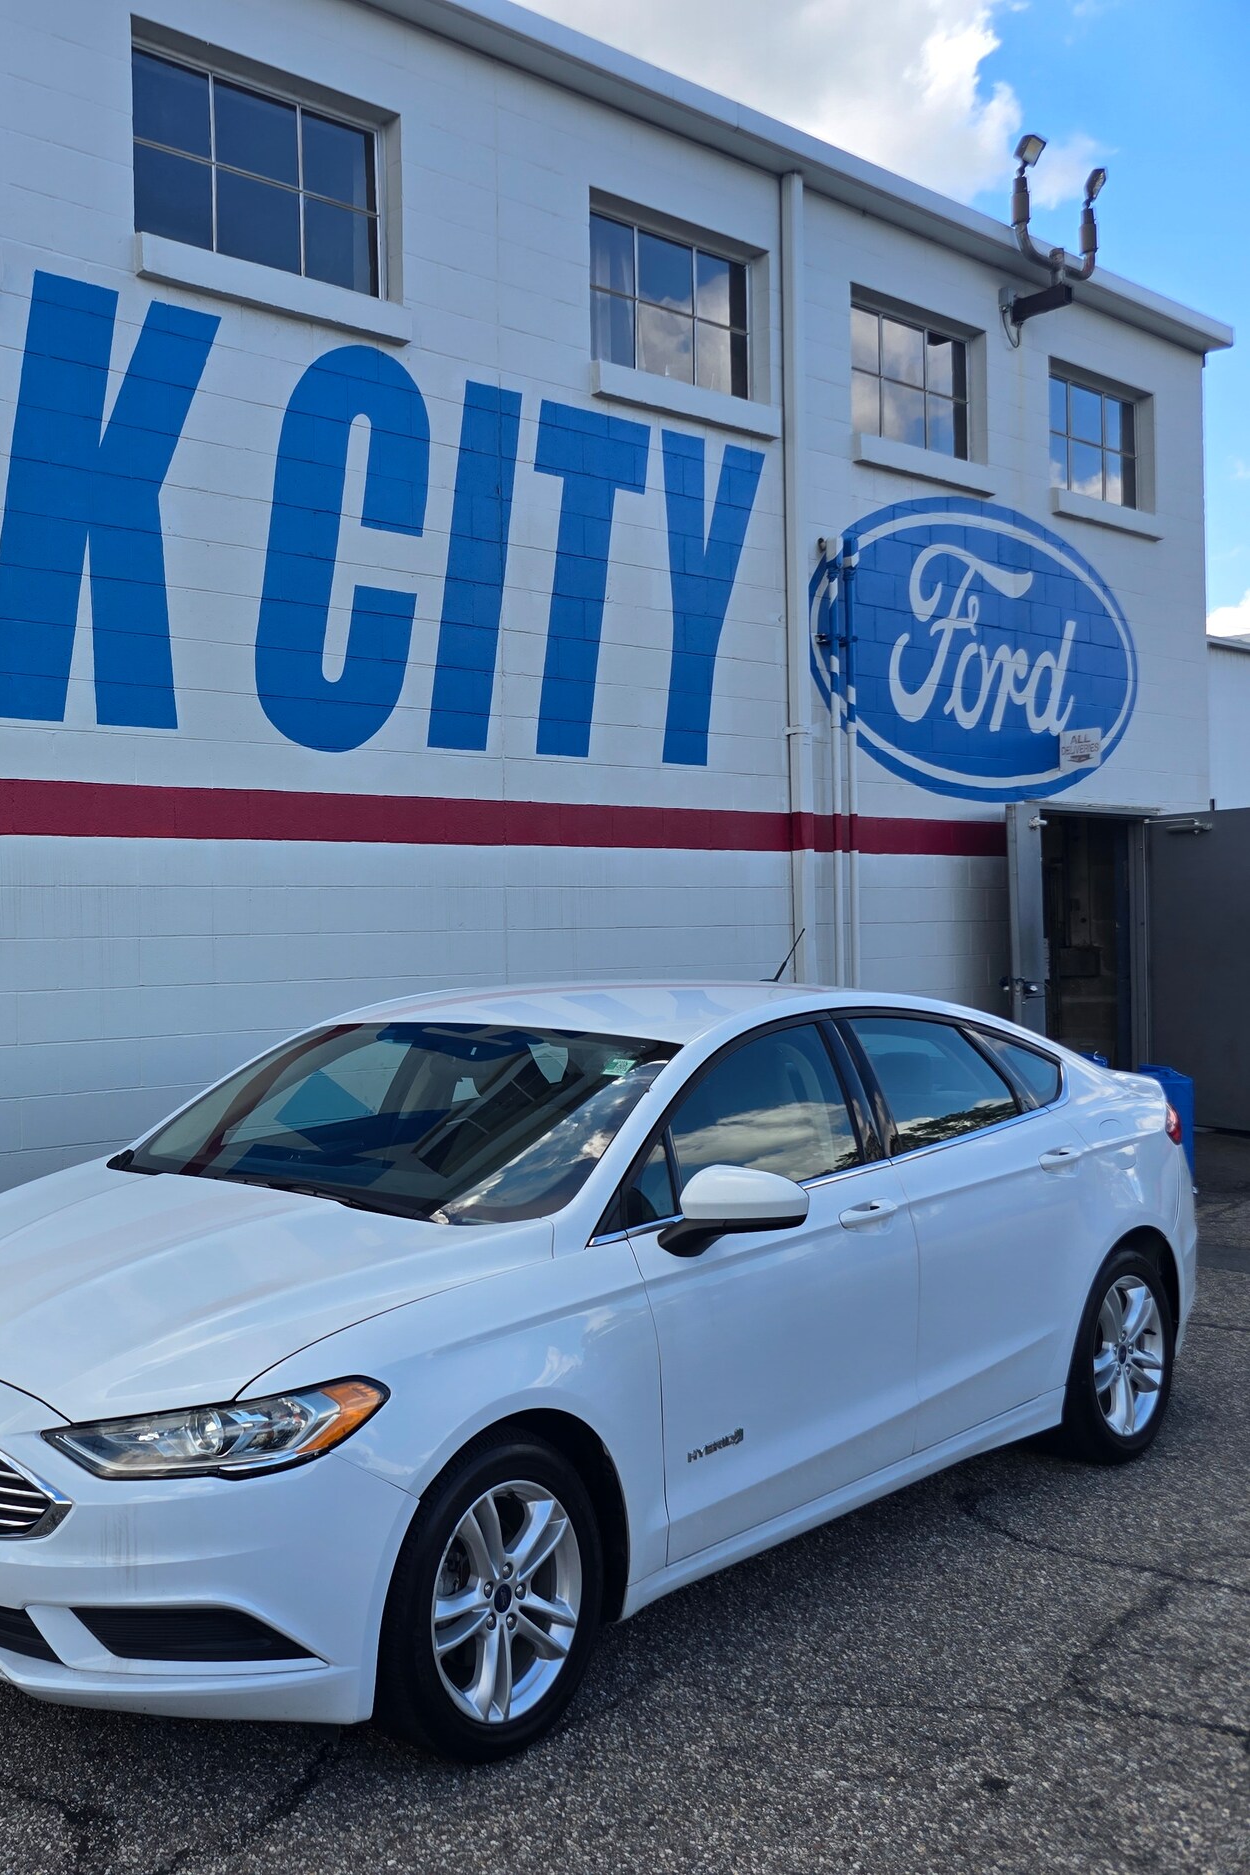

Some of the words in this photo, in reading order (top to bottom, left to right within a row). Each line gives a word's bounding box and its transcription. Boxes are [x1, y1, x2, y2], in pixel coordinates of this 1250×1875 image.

[254, 344, 766, 766] CITY
[889, 543, 1077, 737] Ford
[1061, 742, 1100, 756] DELIVERIES
[1070, 734, 1091, 745] ALL
